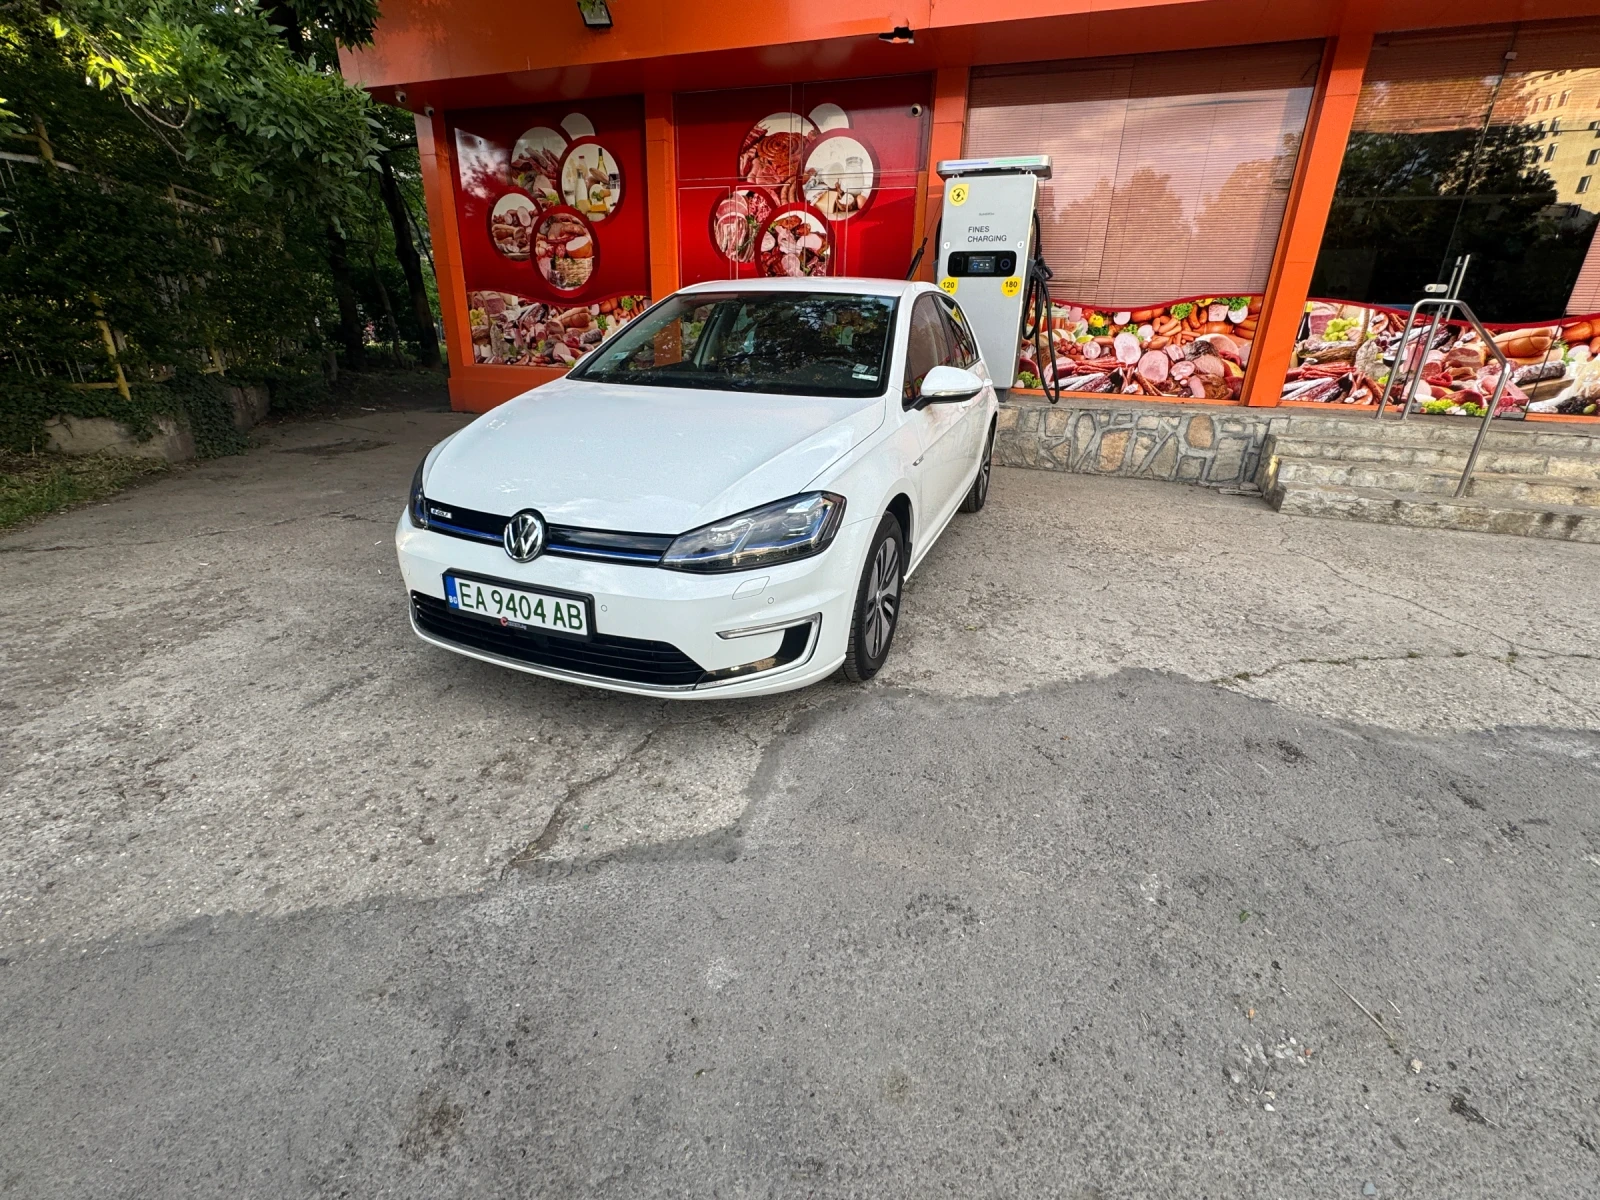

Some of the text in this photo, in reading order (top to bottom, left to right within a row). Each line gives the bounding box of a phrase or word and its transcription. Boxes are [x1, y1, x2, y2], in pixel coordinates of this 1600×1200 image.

[968, 225, 990, 233] FINES
[967, 234, 1007, 243] CHARGING
[943, 281, 955, 289] 120
[1005, 280, 1018, 288] 180
[449, 595, 458, 605] BG
[459, 582, 488, 612] EA
[491, 589, 546, 624] 9404
[553, 601, 583, 630] AB
